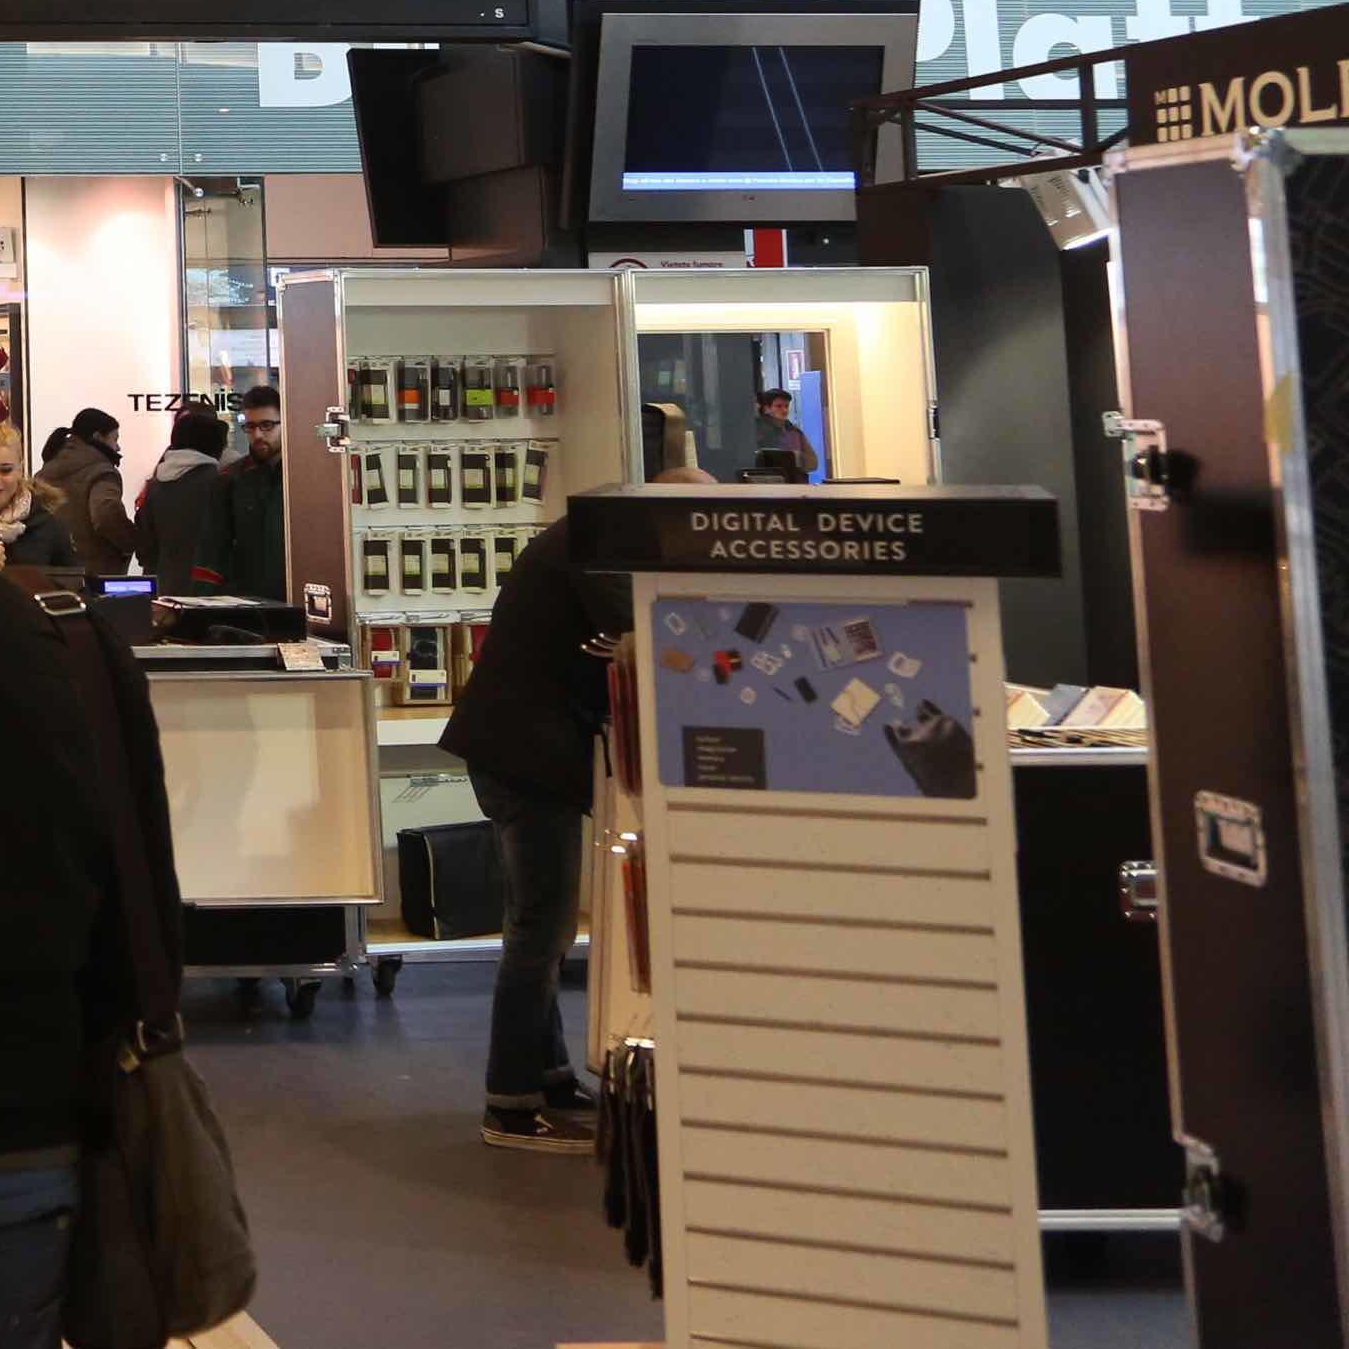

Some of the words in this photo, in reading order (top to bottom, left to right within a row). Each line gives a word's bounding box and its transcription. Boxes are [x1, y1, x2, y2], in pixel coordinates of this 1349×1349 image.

[691, 513, 801, 533] DIGITAL
[818, 513, 924, 534] DEVICE
[710, 540, 907, 562] ACCESSORIES
